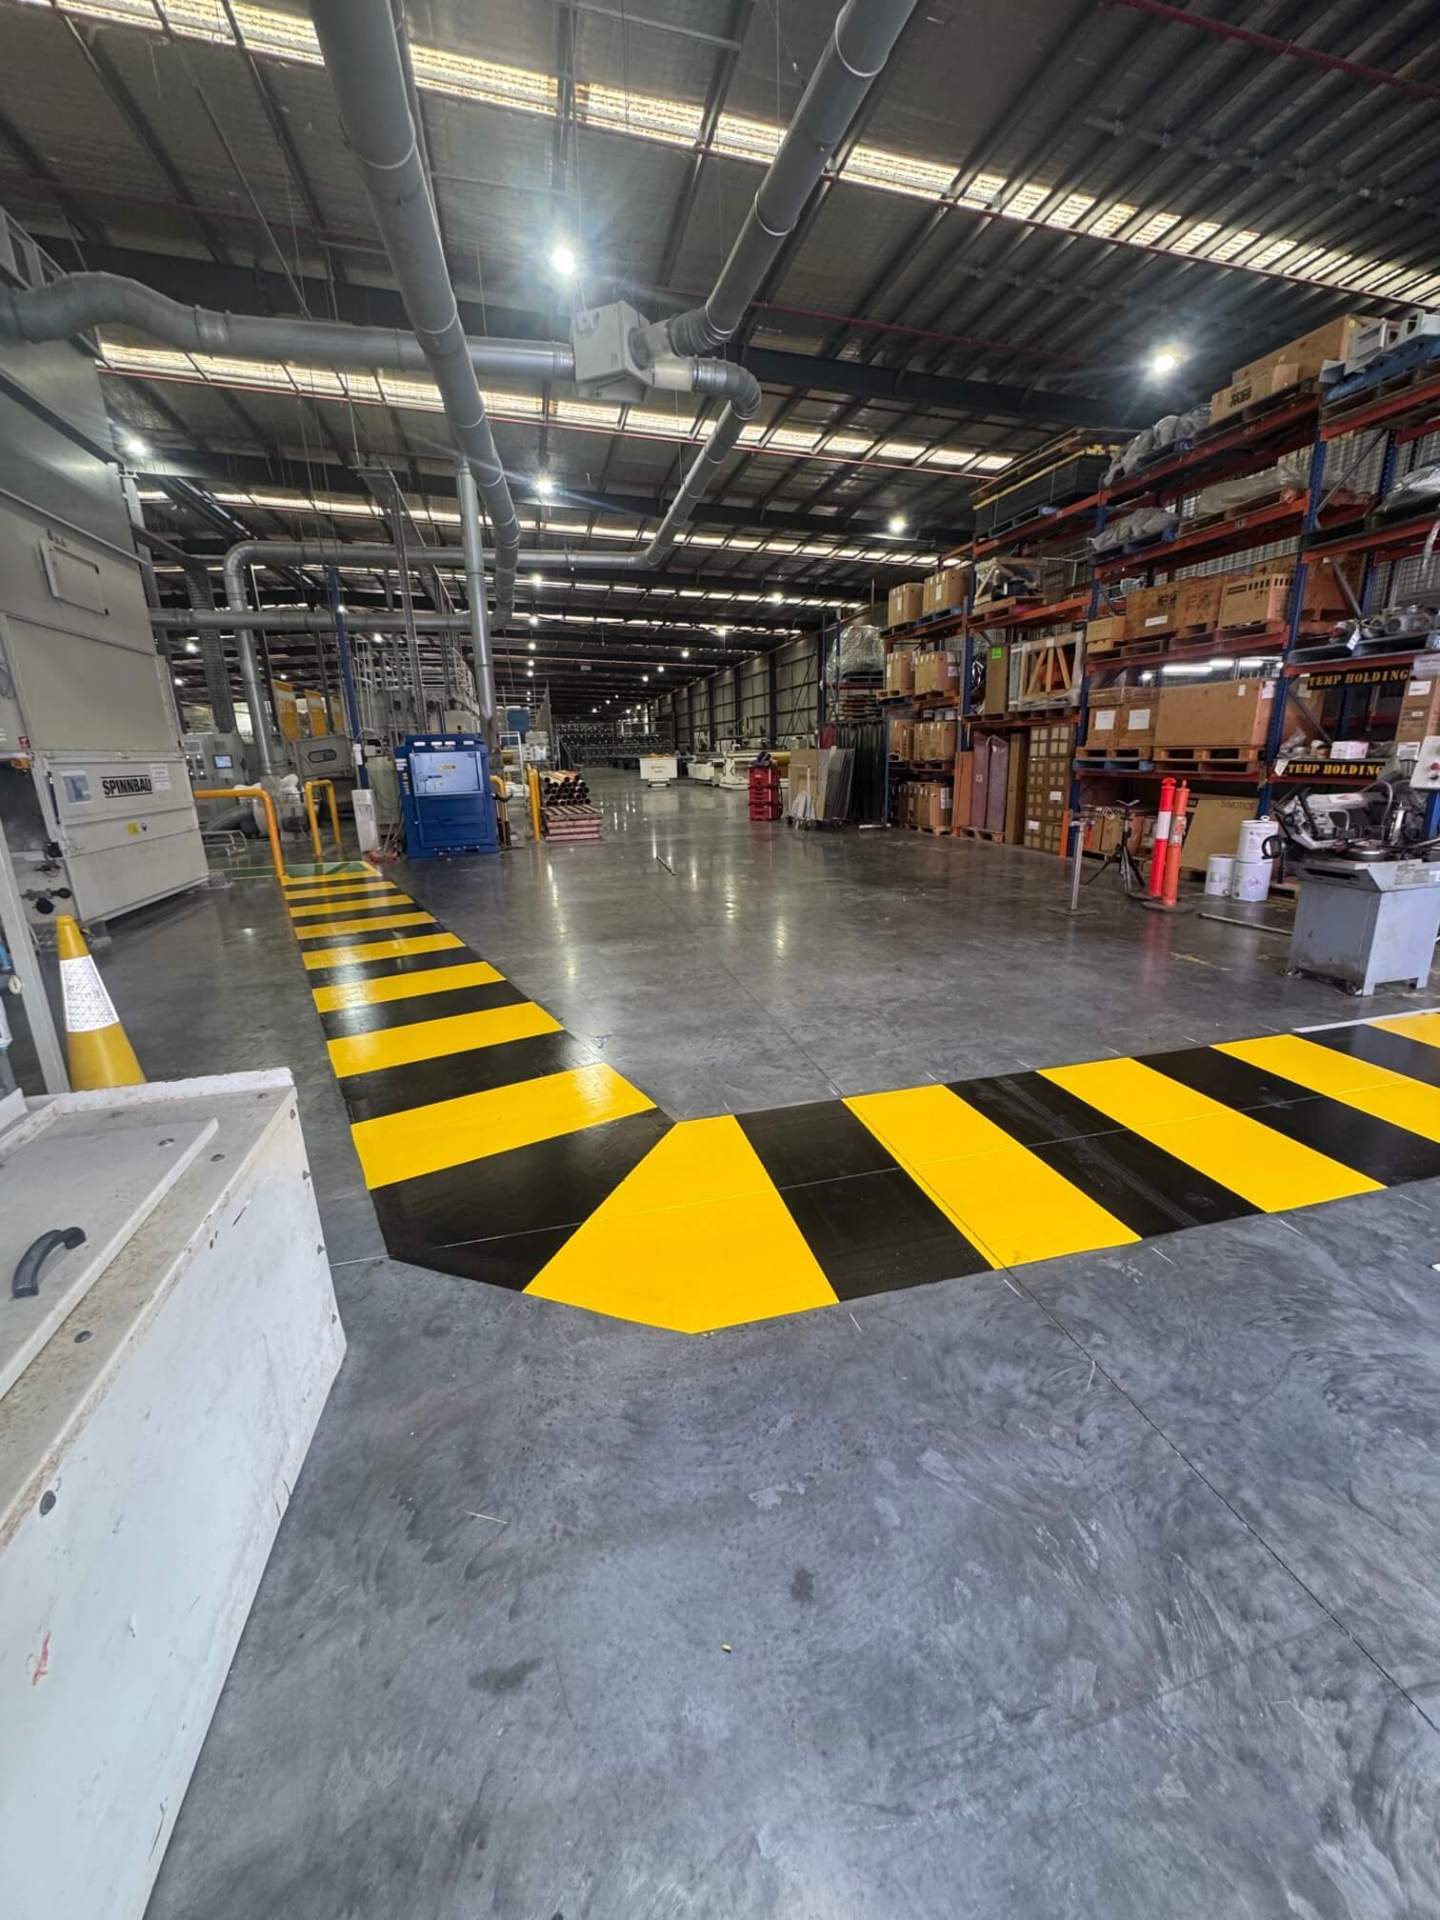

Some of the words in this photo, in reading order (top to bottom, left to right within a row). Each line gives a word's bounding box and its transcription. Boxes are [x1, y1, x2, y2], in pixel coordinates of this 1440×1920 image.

[1308, 674, 1342, 687] TEMP
[1344, 669, 1409, 684] HOLDING
[1288, 764, 1320, 774] TEMP
[102, 778, 152, 795] SPINNBAU
